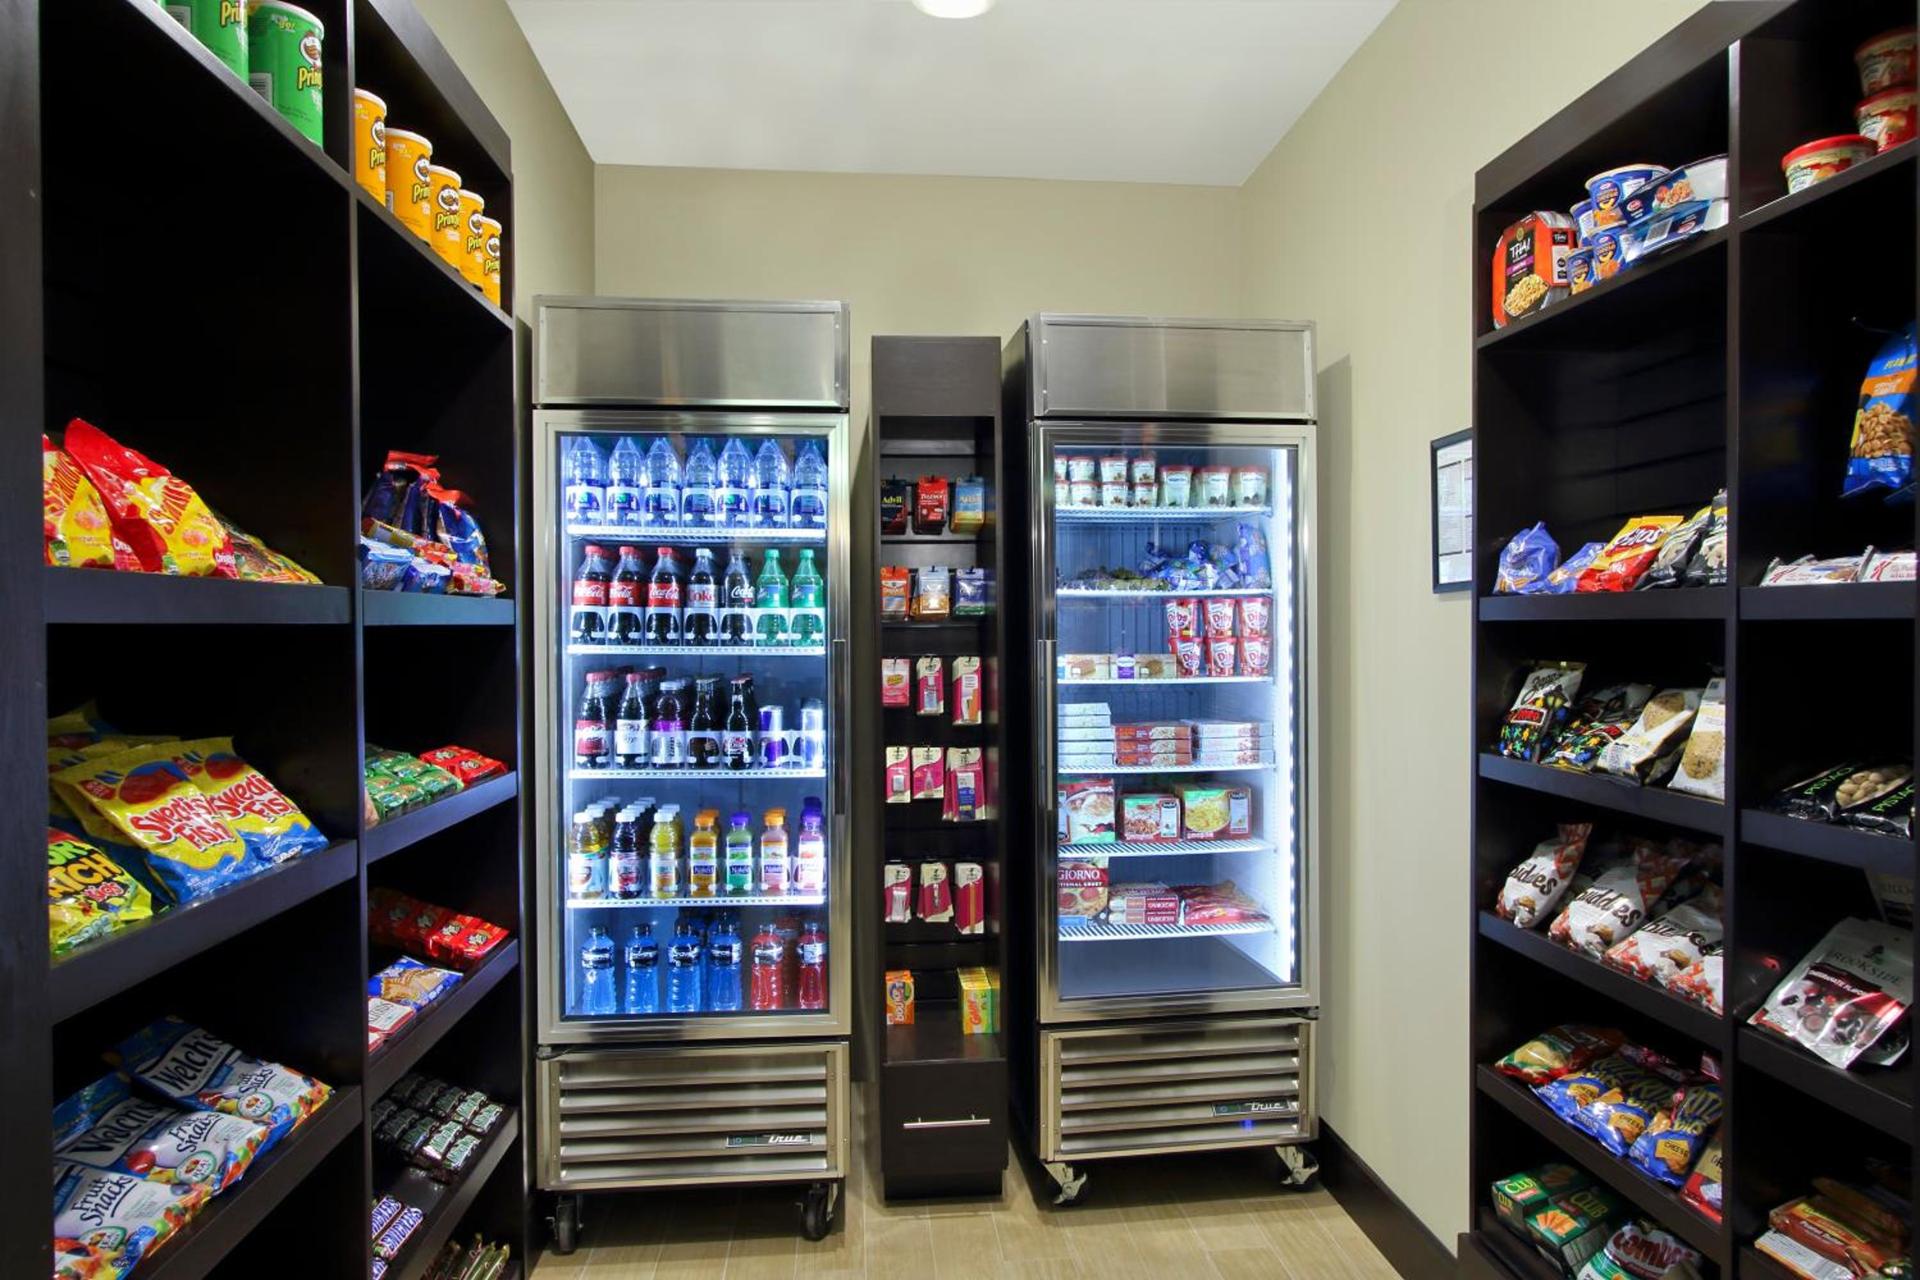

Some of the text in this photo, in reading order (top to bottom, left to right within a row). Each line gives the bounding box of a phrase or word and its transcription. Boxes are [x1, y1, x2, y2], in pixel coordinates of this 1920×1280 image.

[881, 496, 902, 504] Advil
[129, 792, 217, 843] Swedish
[173, 815, 237, 853] Fish
[71, 1176, 110, 1212] Fruit
[79, 1175, 134, 1227] Snacks
